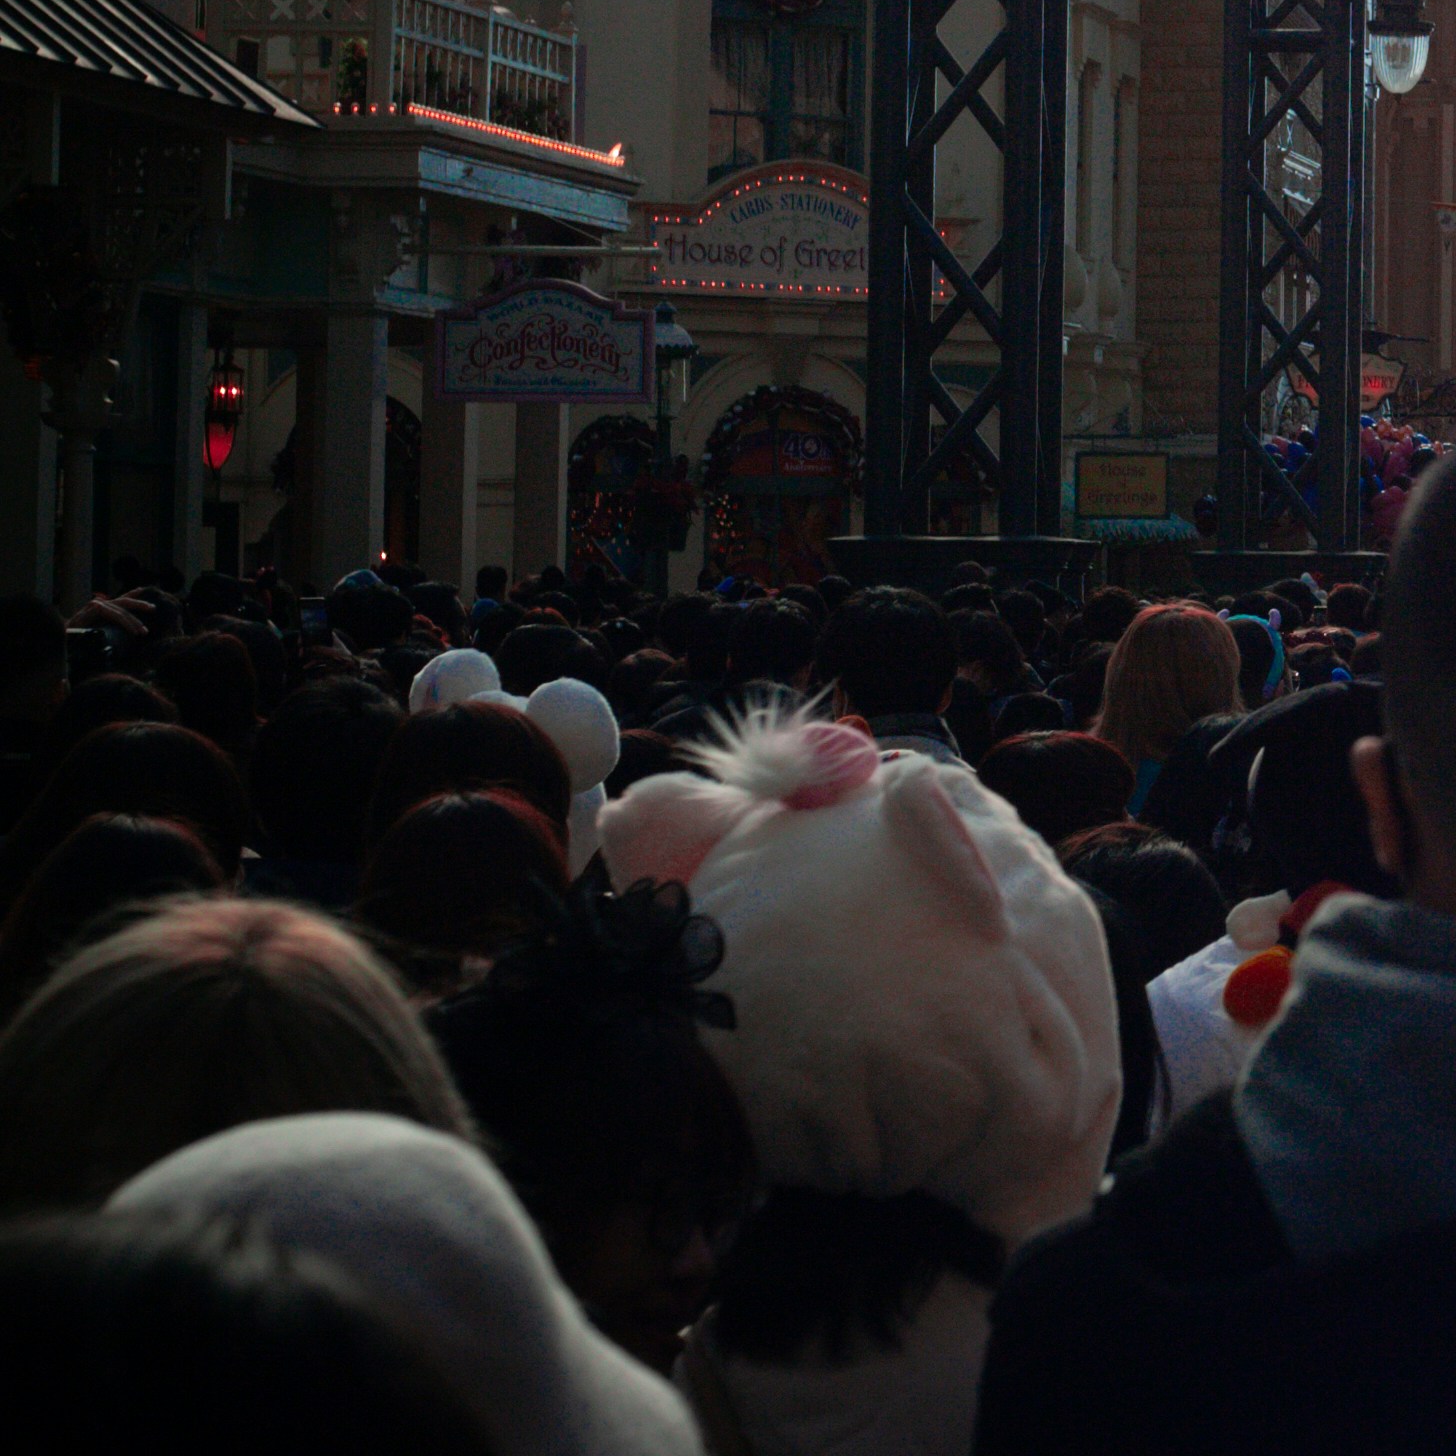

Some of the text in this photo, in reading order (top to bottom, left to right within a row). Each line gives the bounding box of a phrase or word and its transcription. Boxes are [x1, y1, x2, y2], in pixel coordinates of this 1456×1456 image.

[729, 192, 863, 231] CARDS STATIONERY
[664, 233, 867, 273] House of Greet
[466, 314, 622, 377] Confectionery
